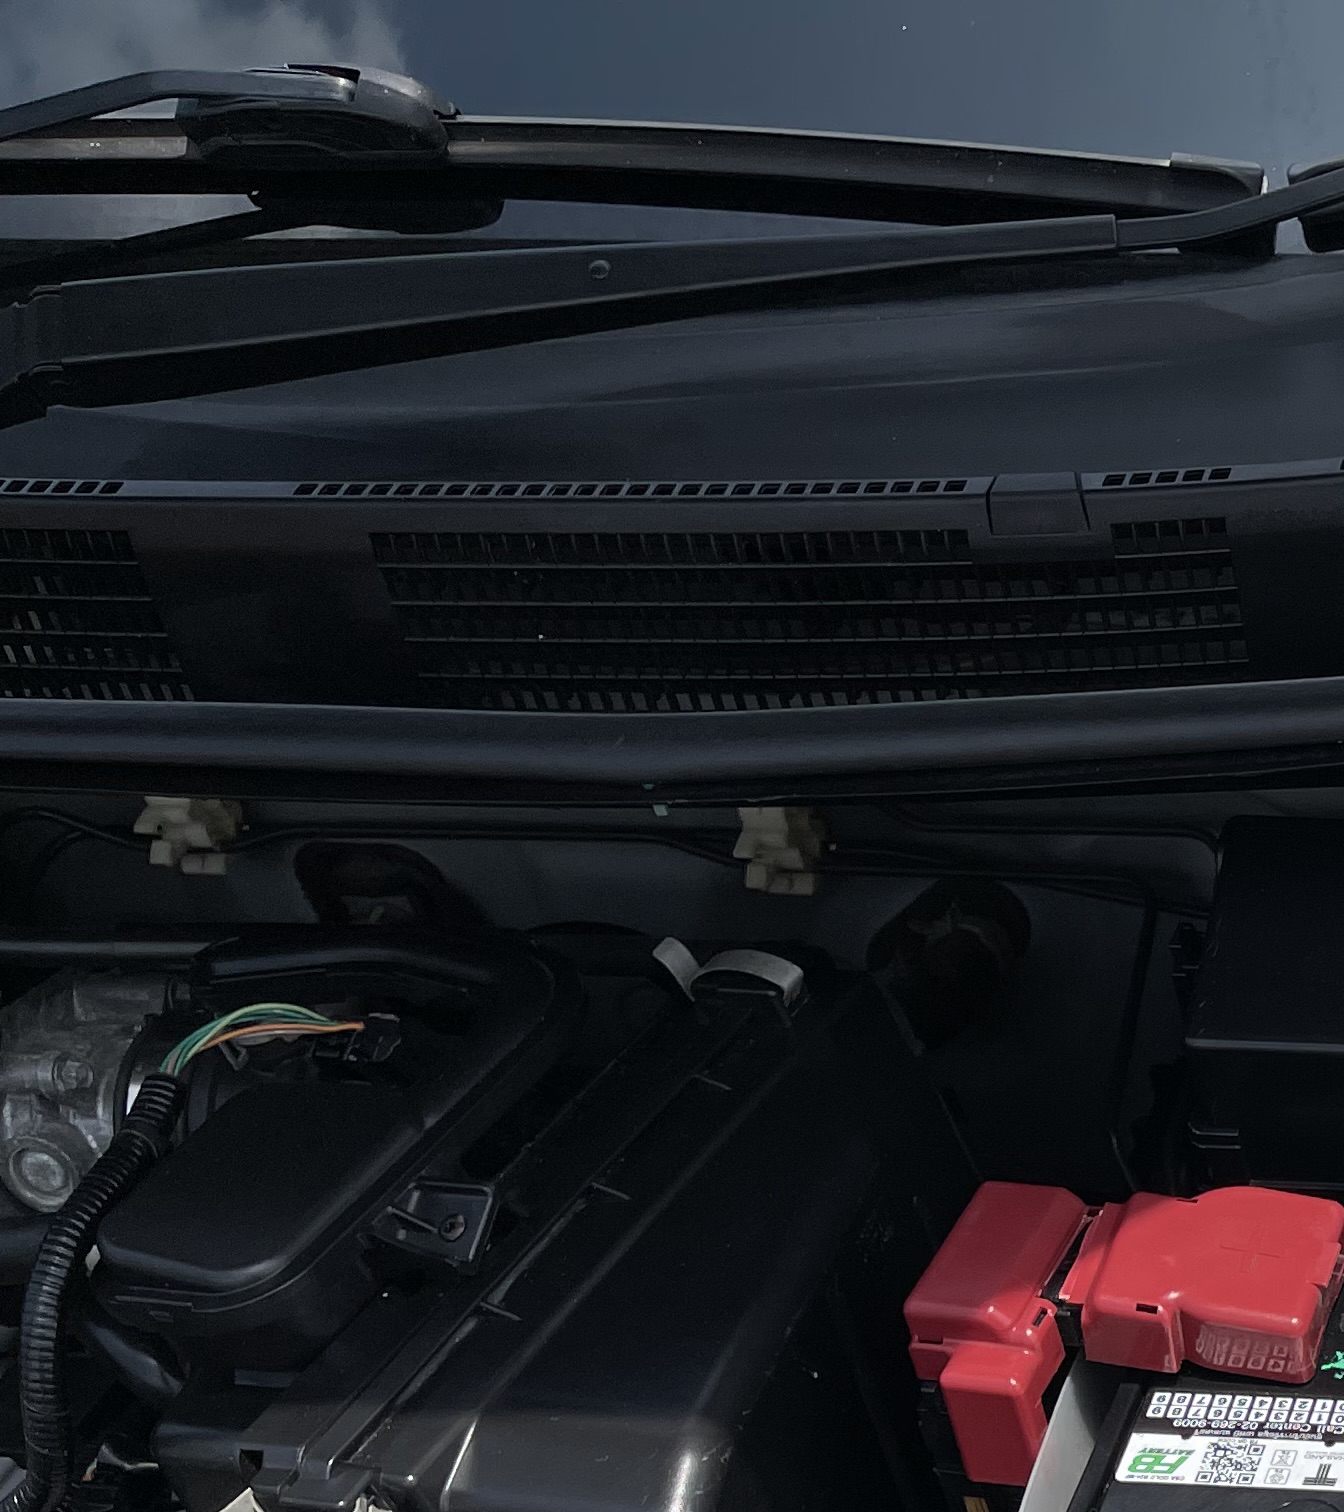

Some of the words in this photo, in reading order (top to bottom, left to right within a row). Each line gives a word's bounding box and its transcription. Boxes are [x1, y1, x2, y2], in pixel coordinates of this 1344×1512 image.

[1263, 1422, 1312, 1432] Center
[1317, 1425, 1344, 1434] Call
[1128, 1454, 1189, 1474] FB
